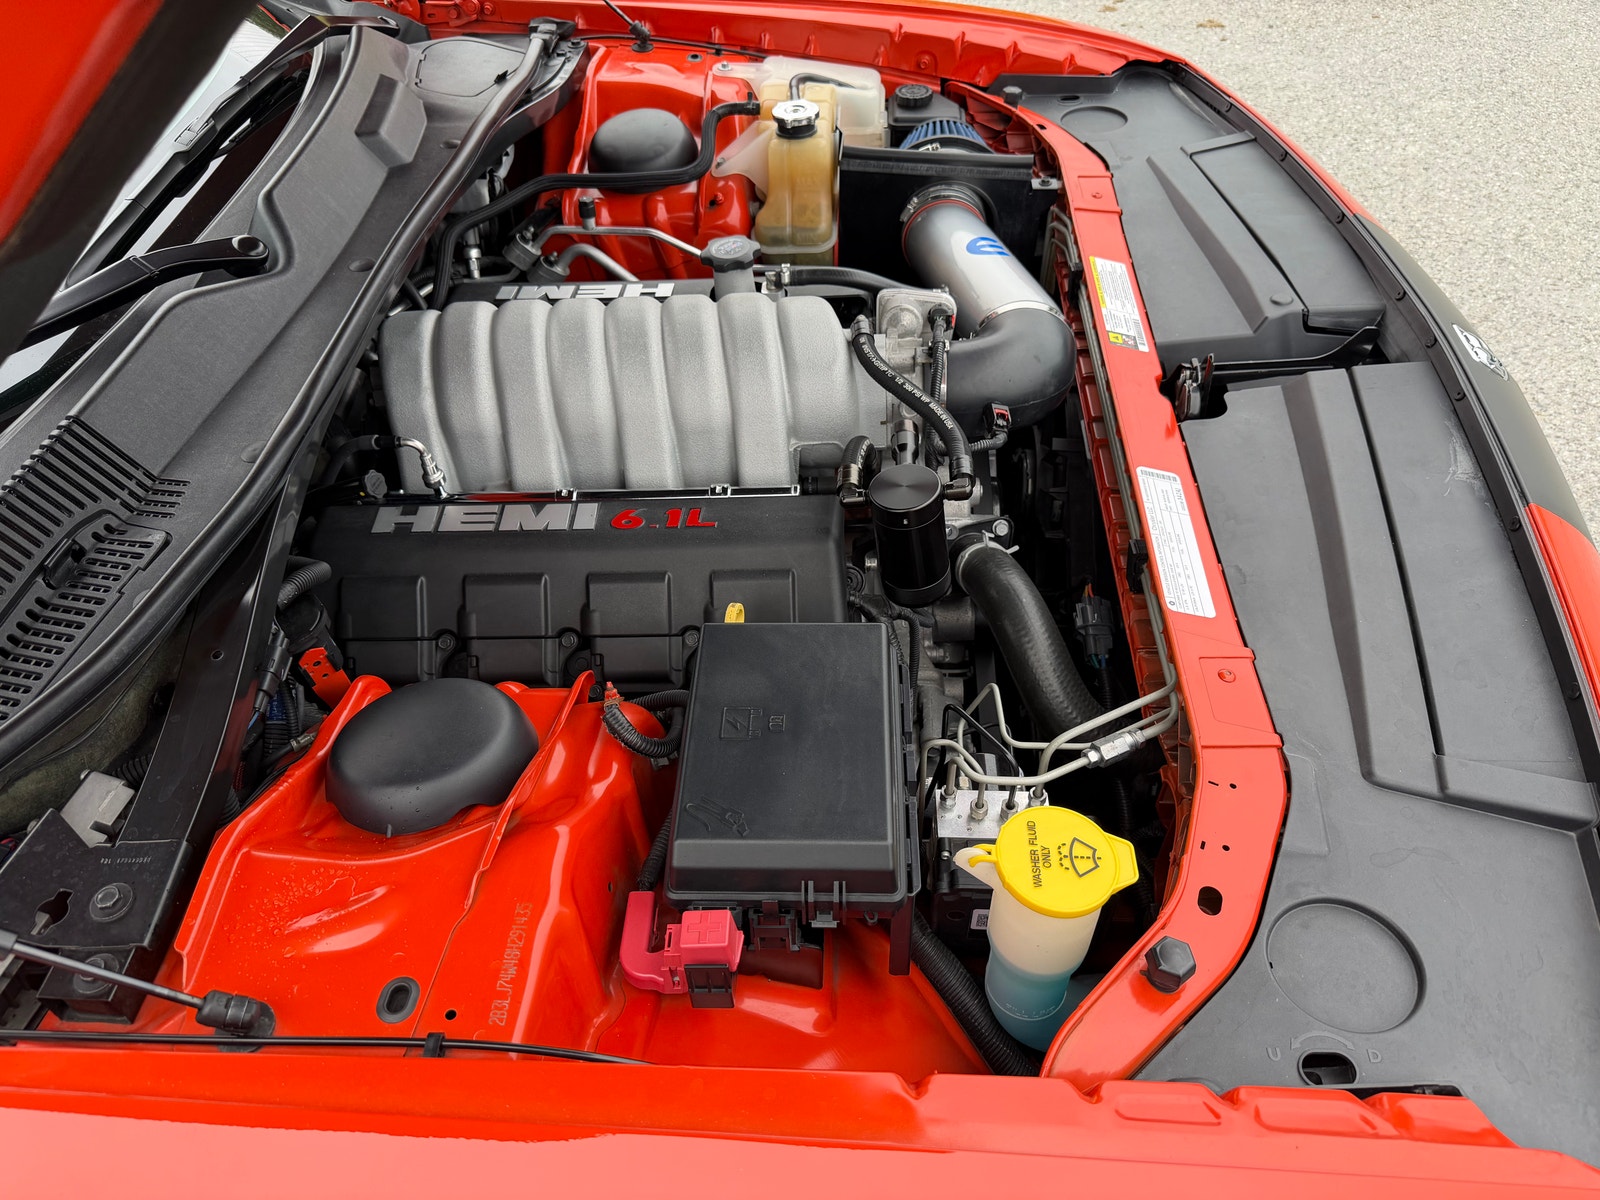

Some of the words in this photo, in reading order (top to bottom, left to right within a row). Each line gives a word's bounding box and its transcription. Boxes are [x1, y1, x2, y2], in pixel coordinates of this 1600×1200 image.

[495, 283, 675, 300] HEMI
[903, 383, 914, 392] 300
[912, 389, 922, 398] PSI
[928, 402, 944, 416] MADE
[943, 418, 954, 430] USA
[371, 503, 599, 533] HEMI
[610, 508, 718, 529] 6.1L
[1026, 820, 1038, 847] FLUID
[1029, 849, 1042, 888] WASHER
[1041, 845, 1052, 869] ONLY
[488, 903, 533, 1026] 2B3LJ74W48H291435
[1266, 1047, 1281, 1061] U
[1367, 1049, 1382, 1063] D
